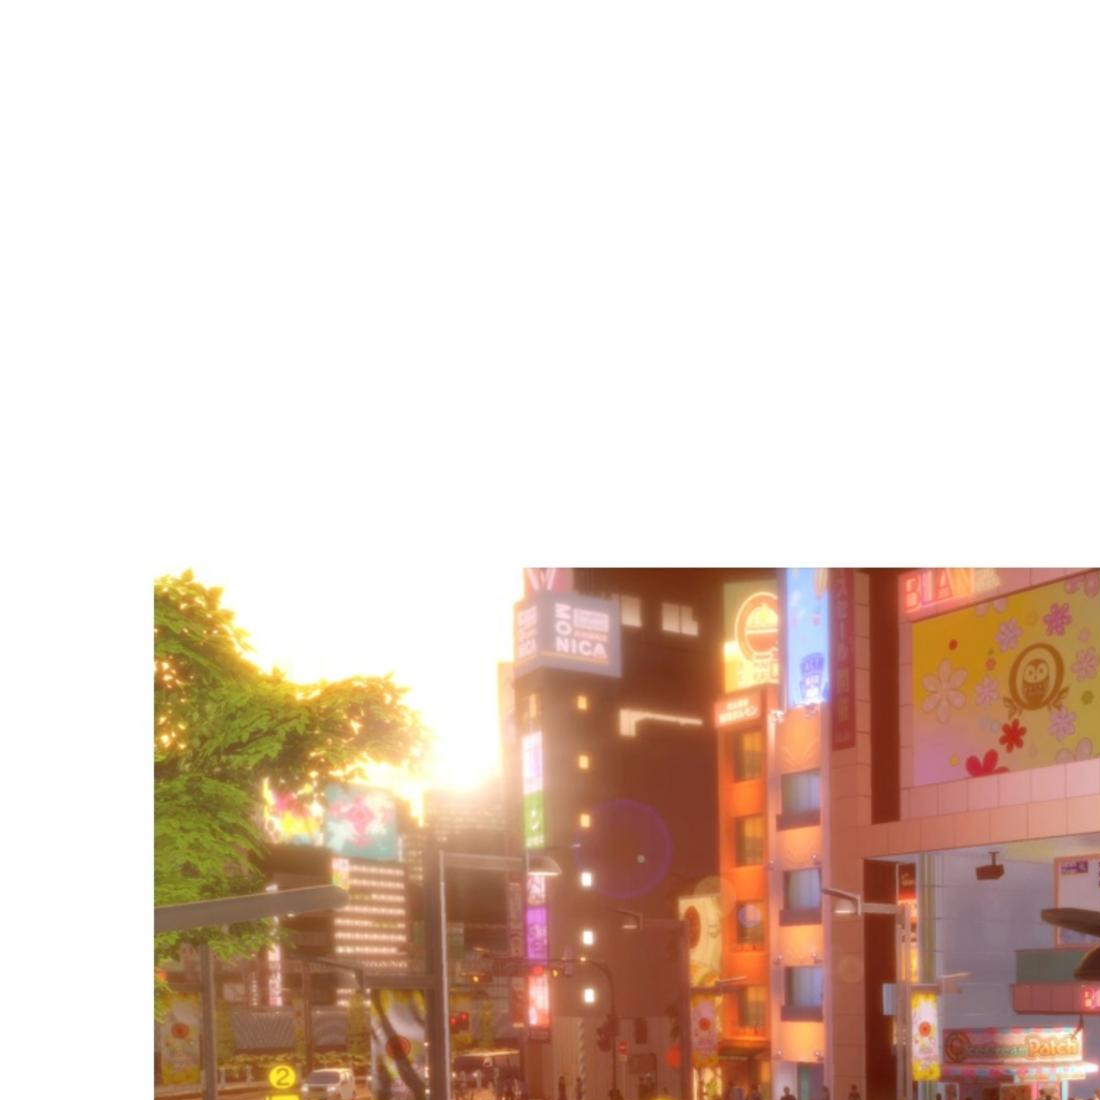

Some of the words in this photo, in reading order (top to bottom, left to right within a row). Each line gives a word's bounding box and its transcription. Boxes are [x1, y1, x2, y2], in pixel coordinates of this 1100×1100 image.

[902, 567, 975, 613] BLAN
[1026, 1036, 1080, 1059] Patch
[276, 1067, 290, 1086] 2
